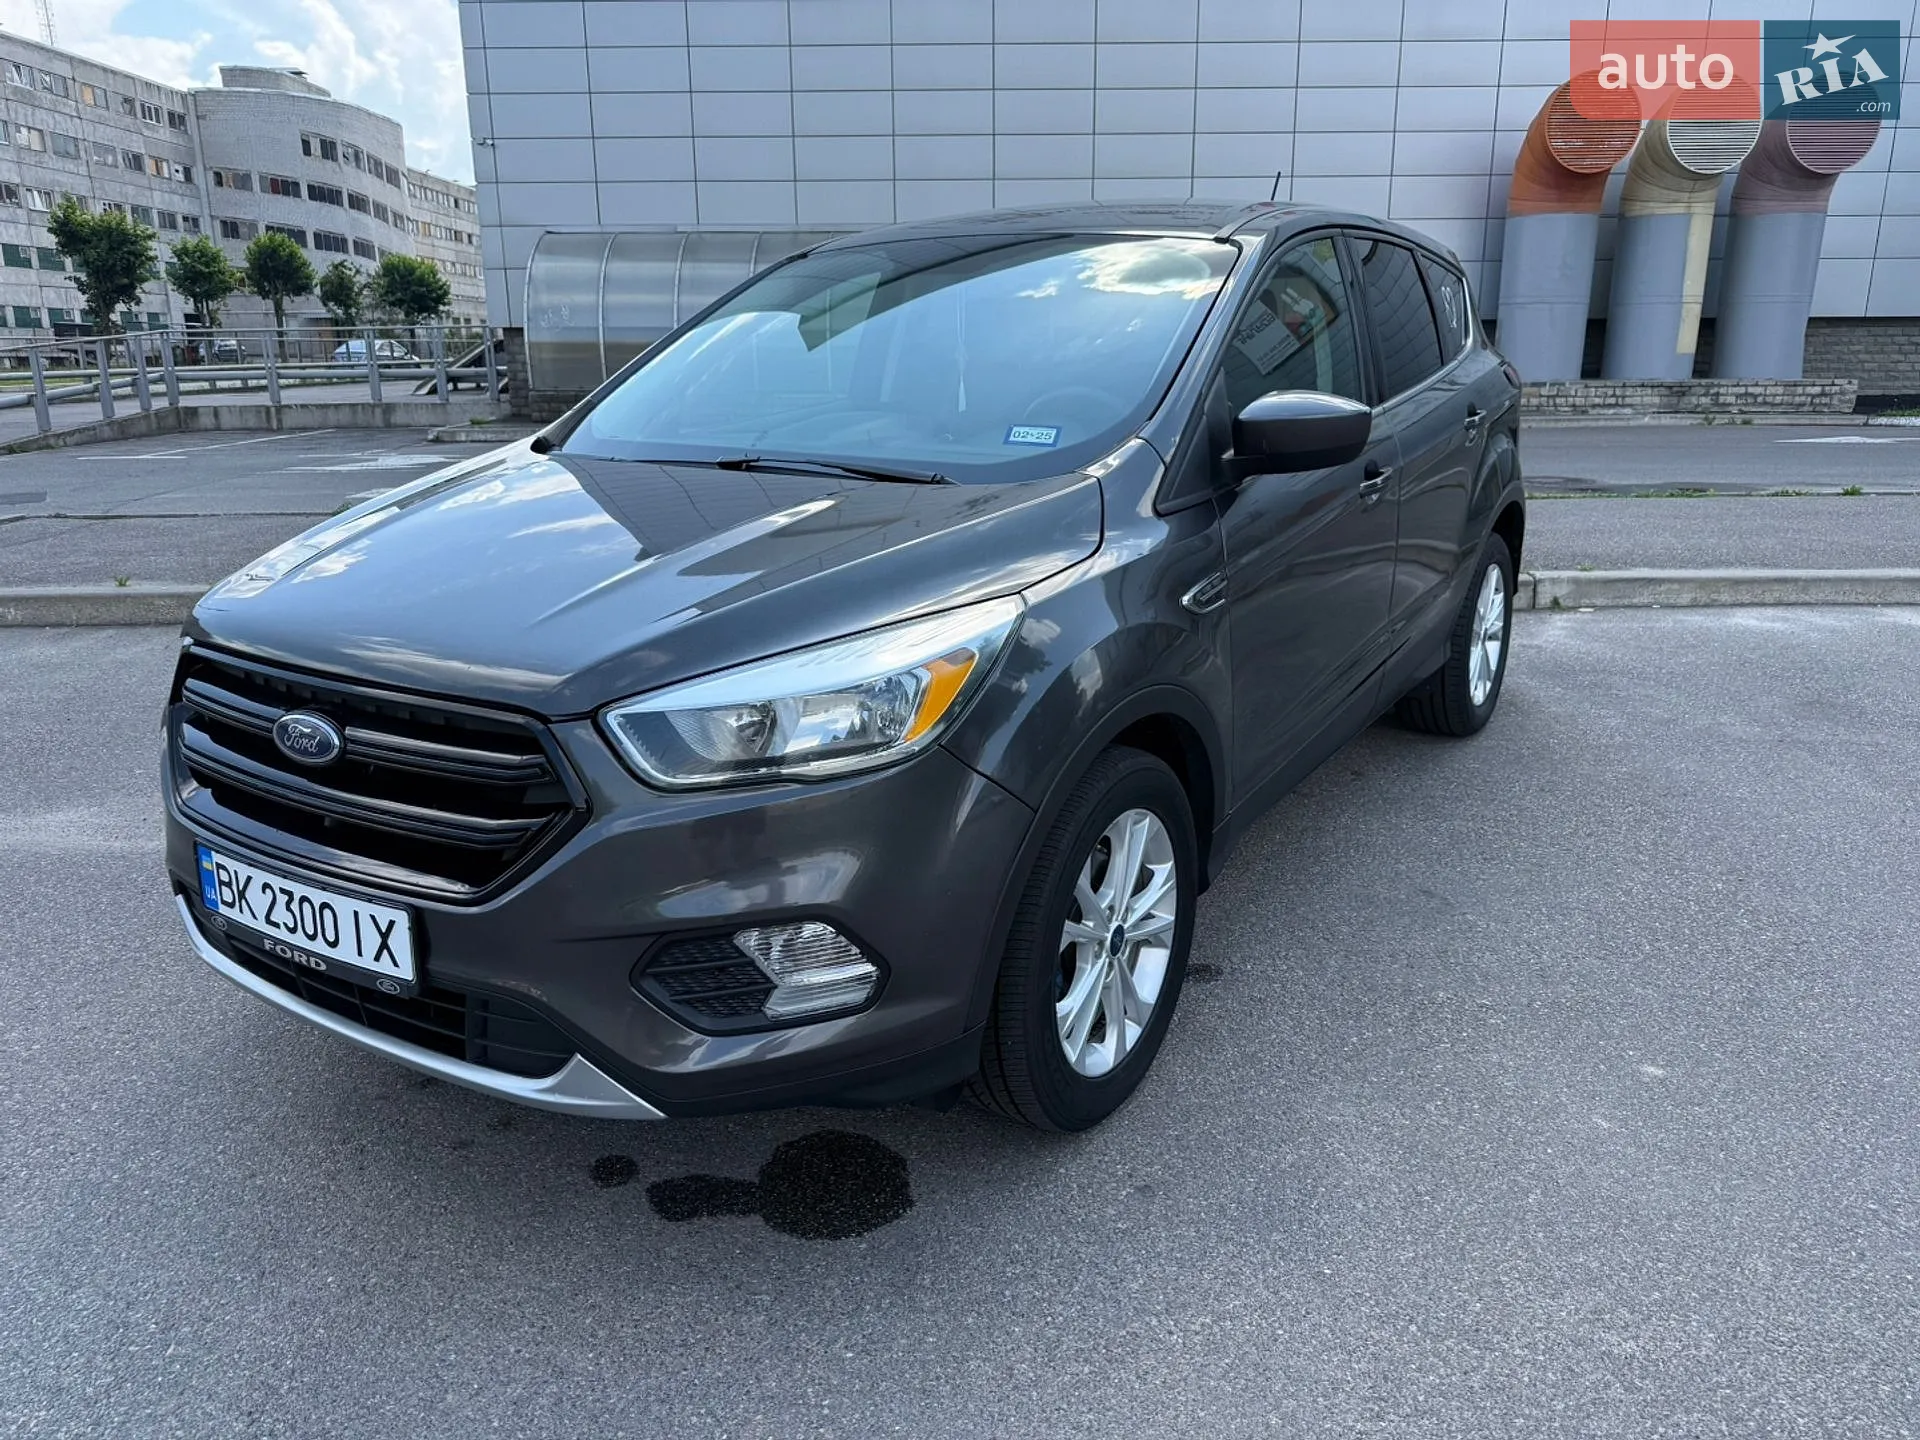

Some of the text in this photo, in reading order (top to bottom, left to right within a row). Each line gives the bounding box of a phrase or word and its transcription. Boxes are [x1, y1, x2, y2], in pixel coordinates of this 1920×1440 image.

[284, 723, 320, 753] Ford
[205, 886, 216, 900] UA
[215, 861, 400, 969] BK 2300 IX
[263, 938, 327, 972] FORD
